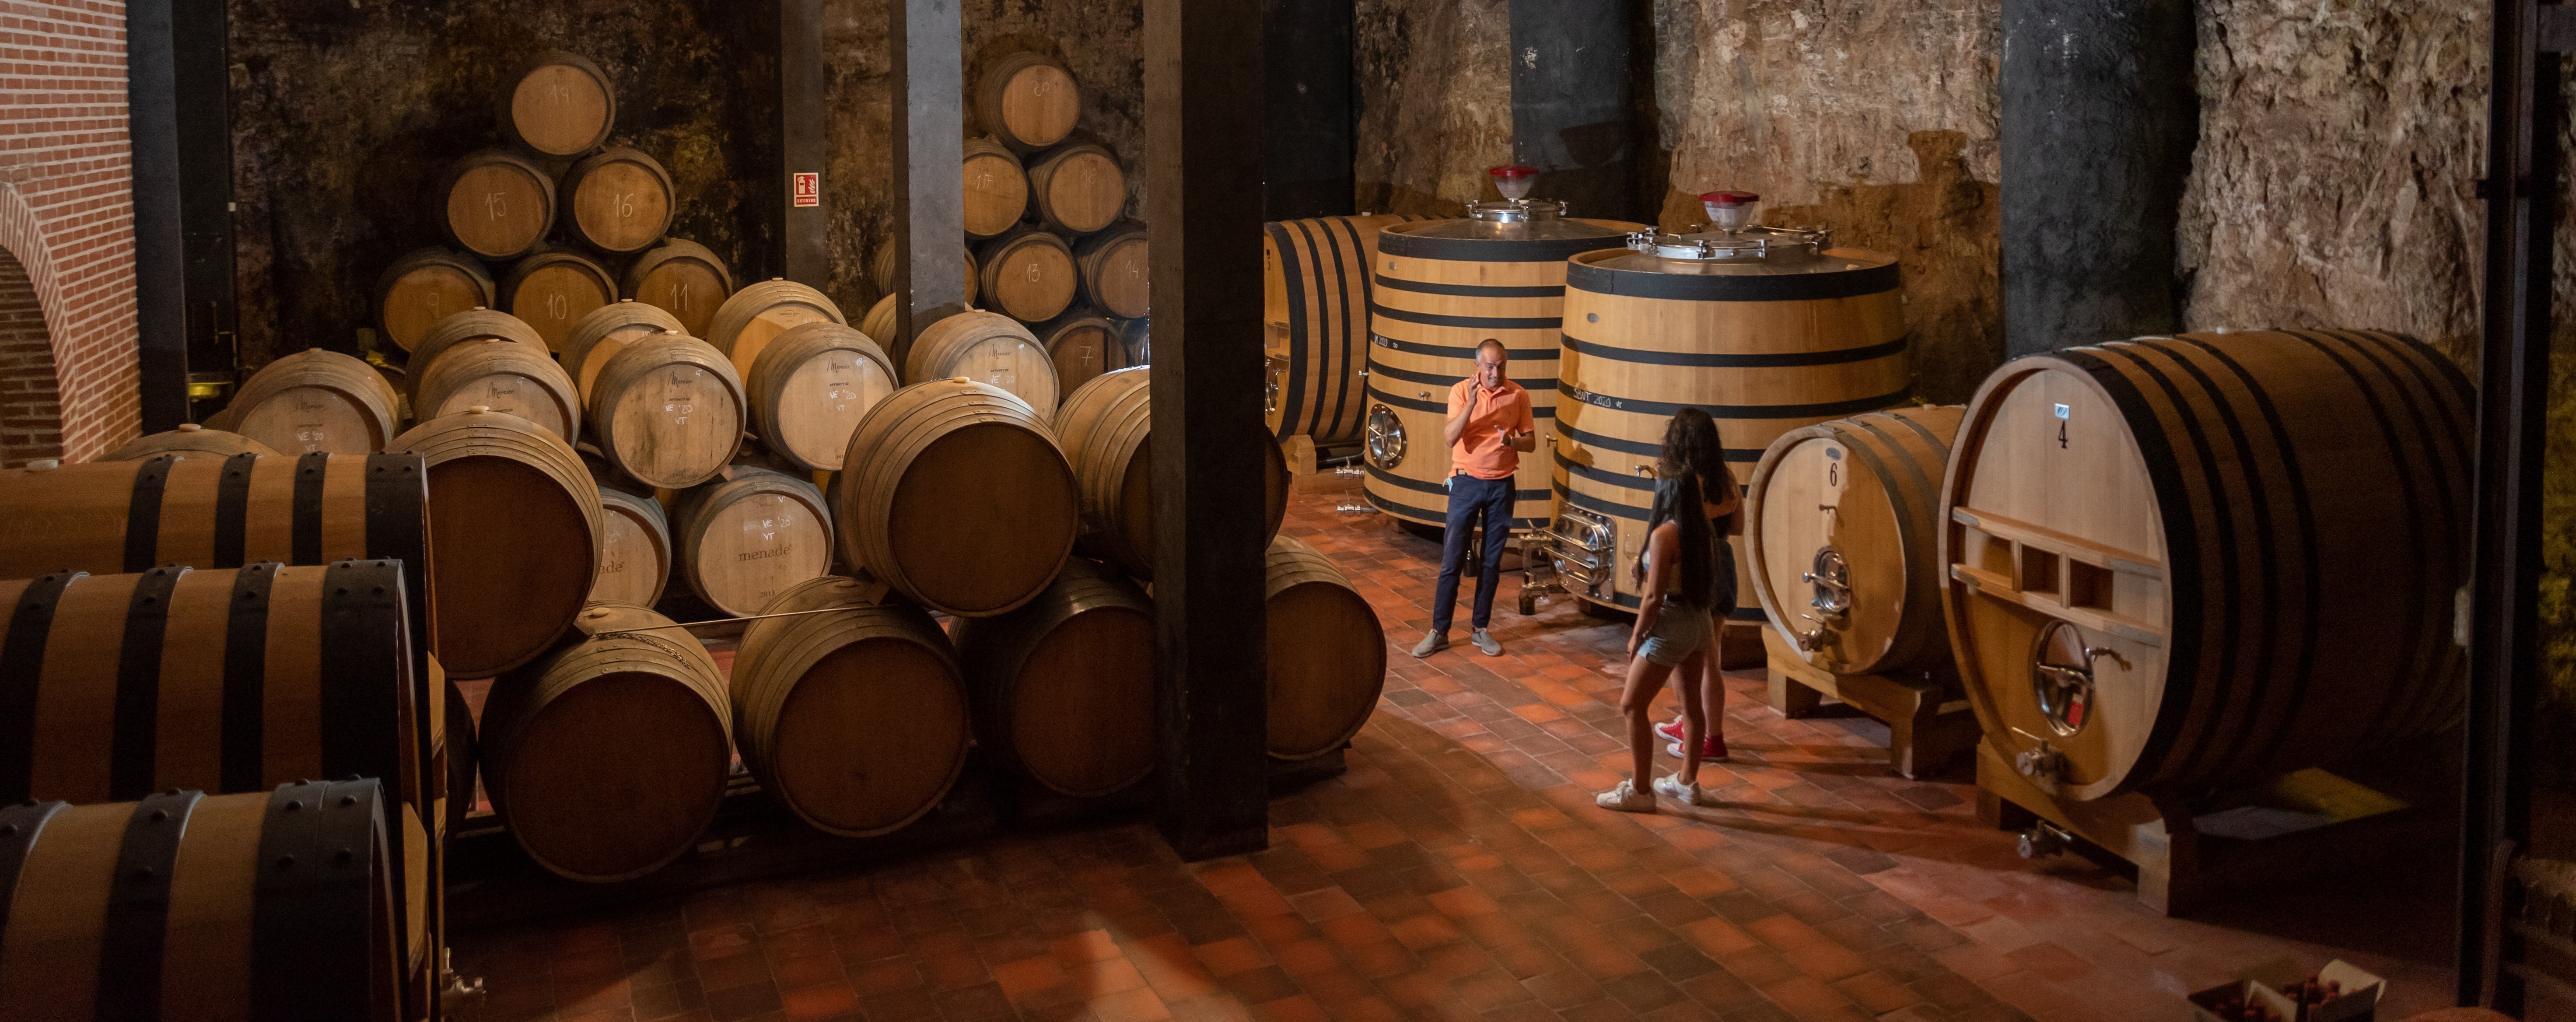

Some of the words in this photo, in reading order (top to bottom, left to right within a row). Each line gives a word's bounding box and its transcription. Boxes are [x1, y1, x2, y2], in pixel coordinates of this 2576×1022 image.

[550, 84, 570, 105] 19
[485, 192, 506, 220] 15
[613, 193, 634, 218] 16
[1026, 263, 1040, 283] 13
[1125, 259, 1138, 279] 14
[548, 294, 567, 319] 10
[670, 284, 687, 311] 11
[988, 344, 1011, 360] Mercier
[1079, 346, 1094, 366] 7
[827, 357, 850, 373] Mercier
[667, 371, 693, 388] Mercier
[990, 375, 1001, 384] VE
[486, 382, 514, 399] Mercier
[830, 390, 838, 399] VE
[297, 432, 309, 441] VE
[2058, 420, 2068, 448] 4
[1830, 462, 1838, 486] 6
[763, 519, 772, 528] VE
[763, 532, 775, 540] VT
[600, 560, 623, 574] ade
